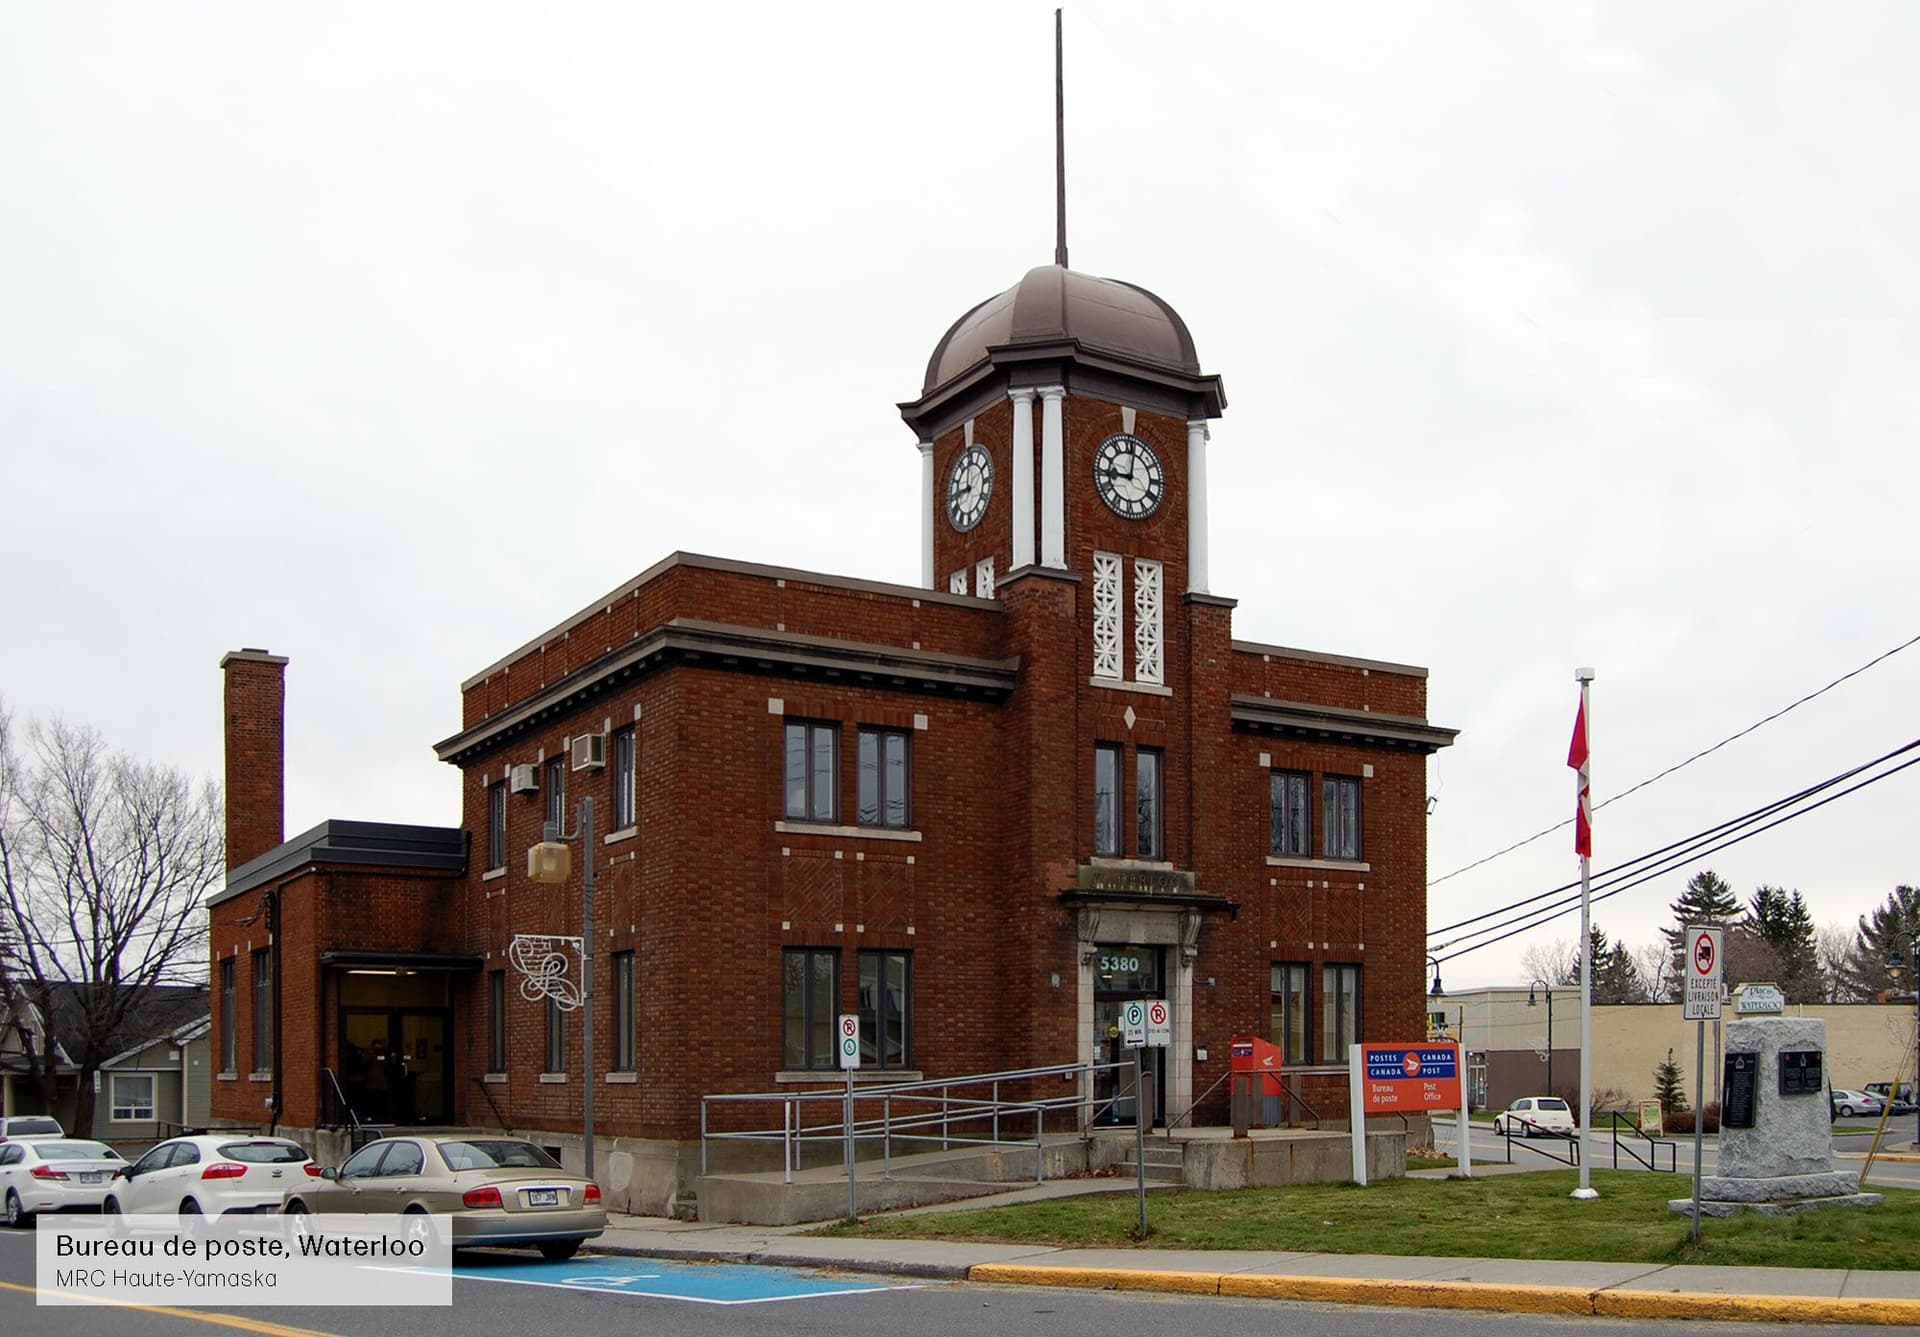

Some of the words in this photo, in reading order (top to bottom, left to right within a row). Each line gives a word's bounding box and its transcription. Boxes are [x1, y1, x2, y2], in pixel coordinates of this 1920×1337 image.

[1100, 956, 1139, 972] 5380
[1688, 991, 1719, 1002] LIVRAISON
[1692, 1003, 1714, 1015] LOCALE
[1370, 1054, 1397, 1062] POSTES
[1422, 1053, 1451, 1061] CANADA
[1370, 1068, 1401, 1076] CANADA
[1422, 1067, 1440, 1075] POST
[1372, 1084, 1394, 1093] Bureau
[1423, 1082, 1436, 1091] Post
[1373, 1094, 1380, 1103] de
[1381, 1094, 1398, 1105] poste
[1423, 1092, 1441, 1101] Office
